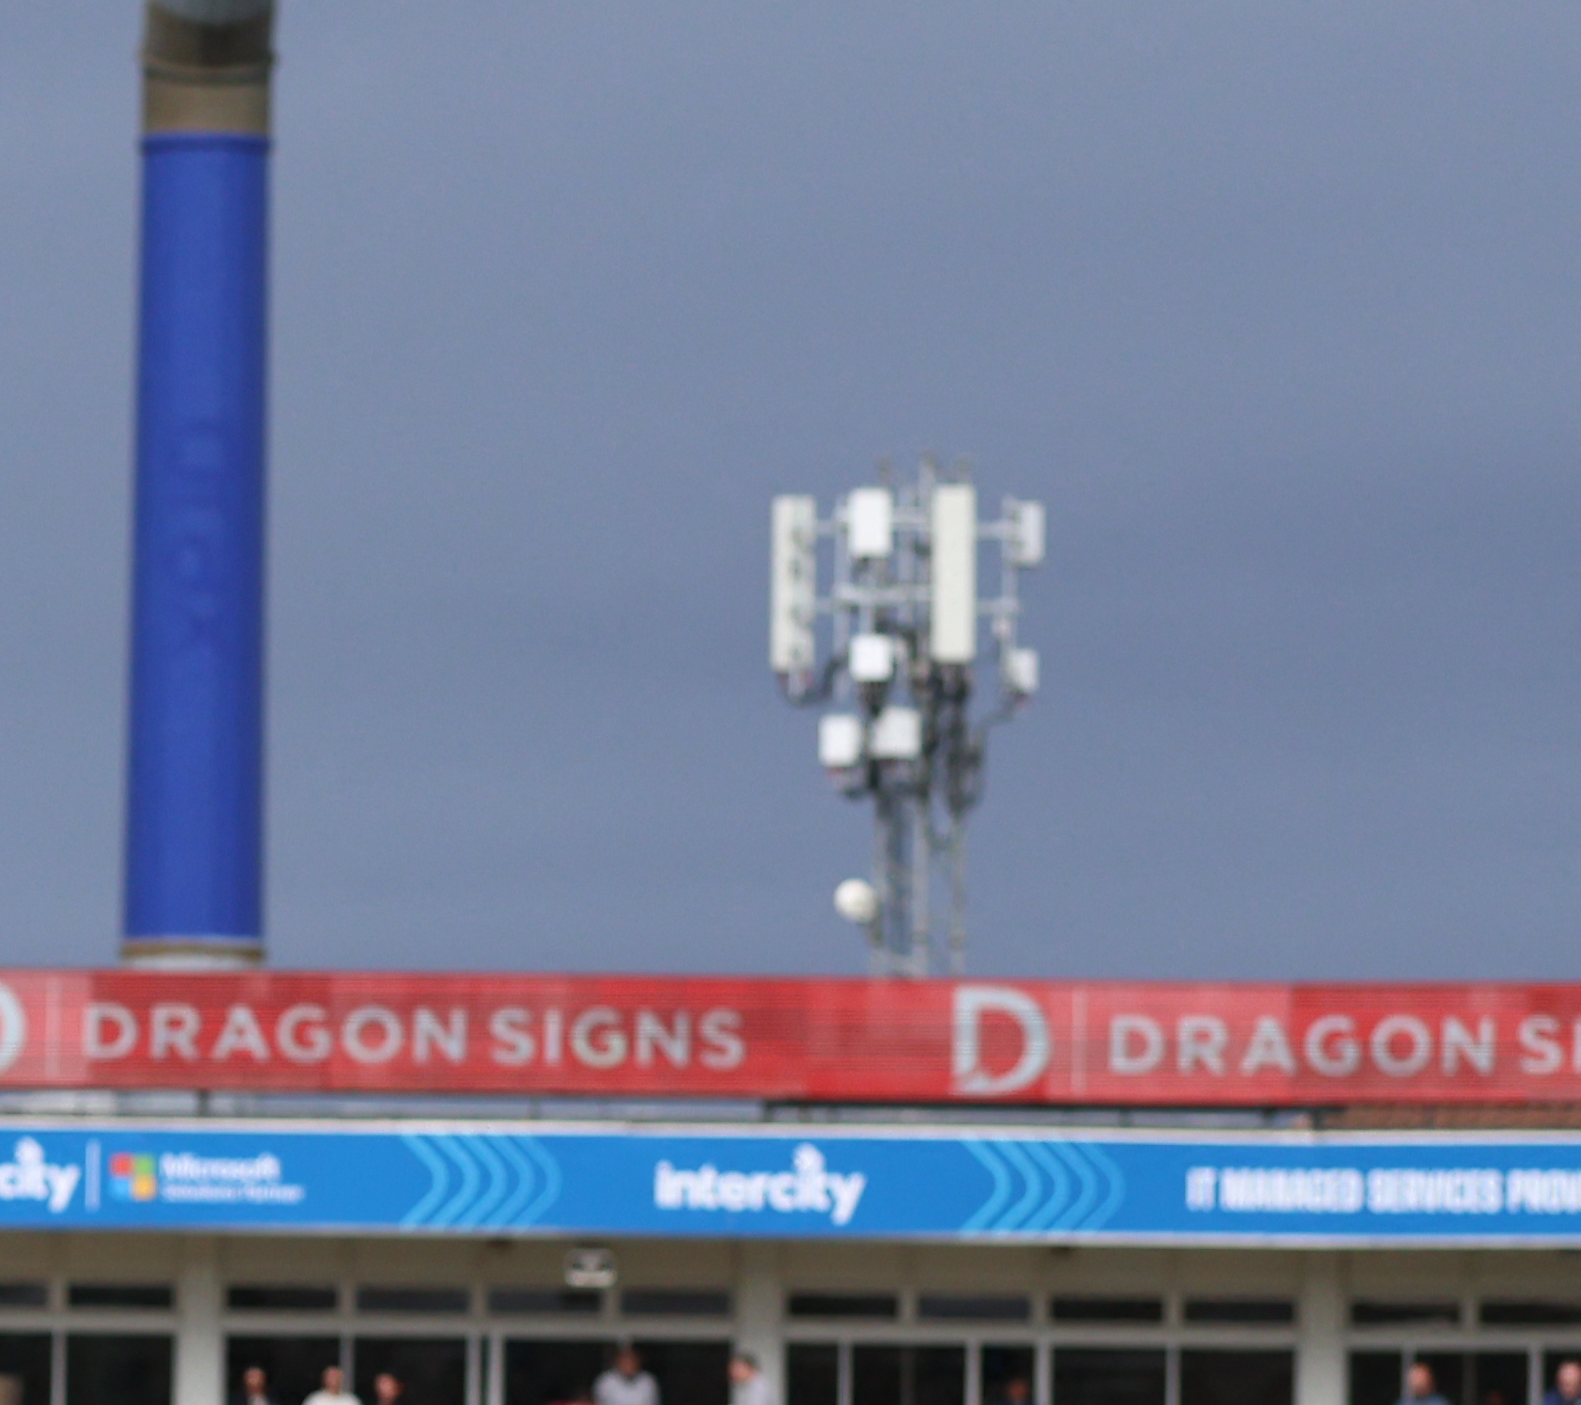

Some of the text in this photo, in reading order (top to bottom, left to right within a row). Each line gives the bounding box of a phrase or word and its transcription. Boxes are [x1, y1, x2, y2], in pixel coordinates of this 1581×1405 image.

[82, 1000, 469, 1066] DRAGON
[491, 1003, 747, 1069] SIGNS
[953, 986, 1051, 1094] D
[1110, 1013, 1496, 1077] DRAGON
[1219, 1166, 1365, 1213] MANAGED
[1367, 1168, 1503, 1214] SERVICES
